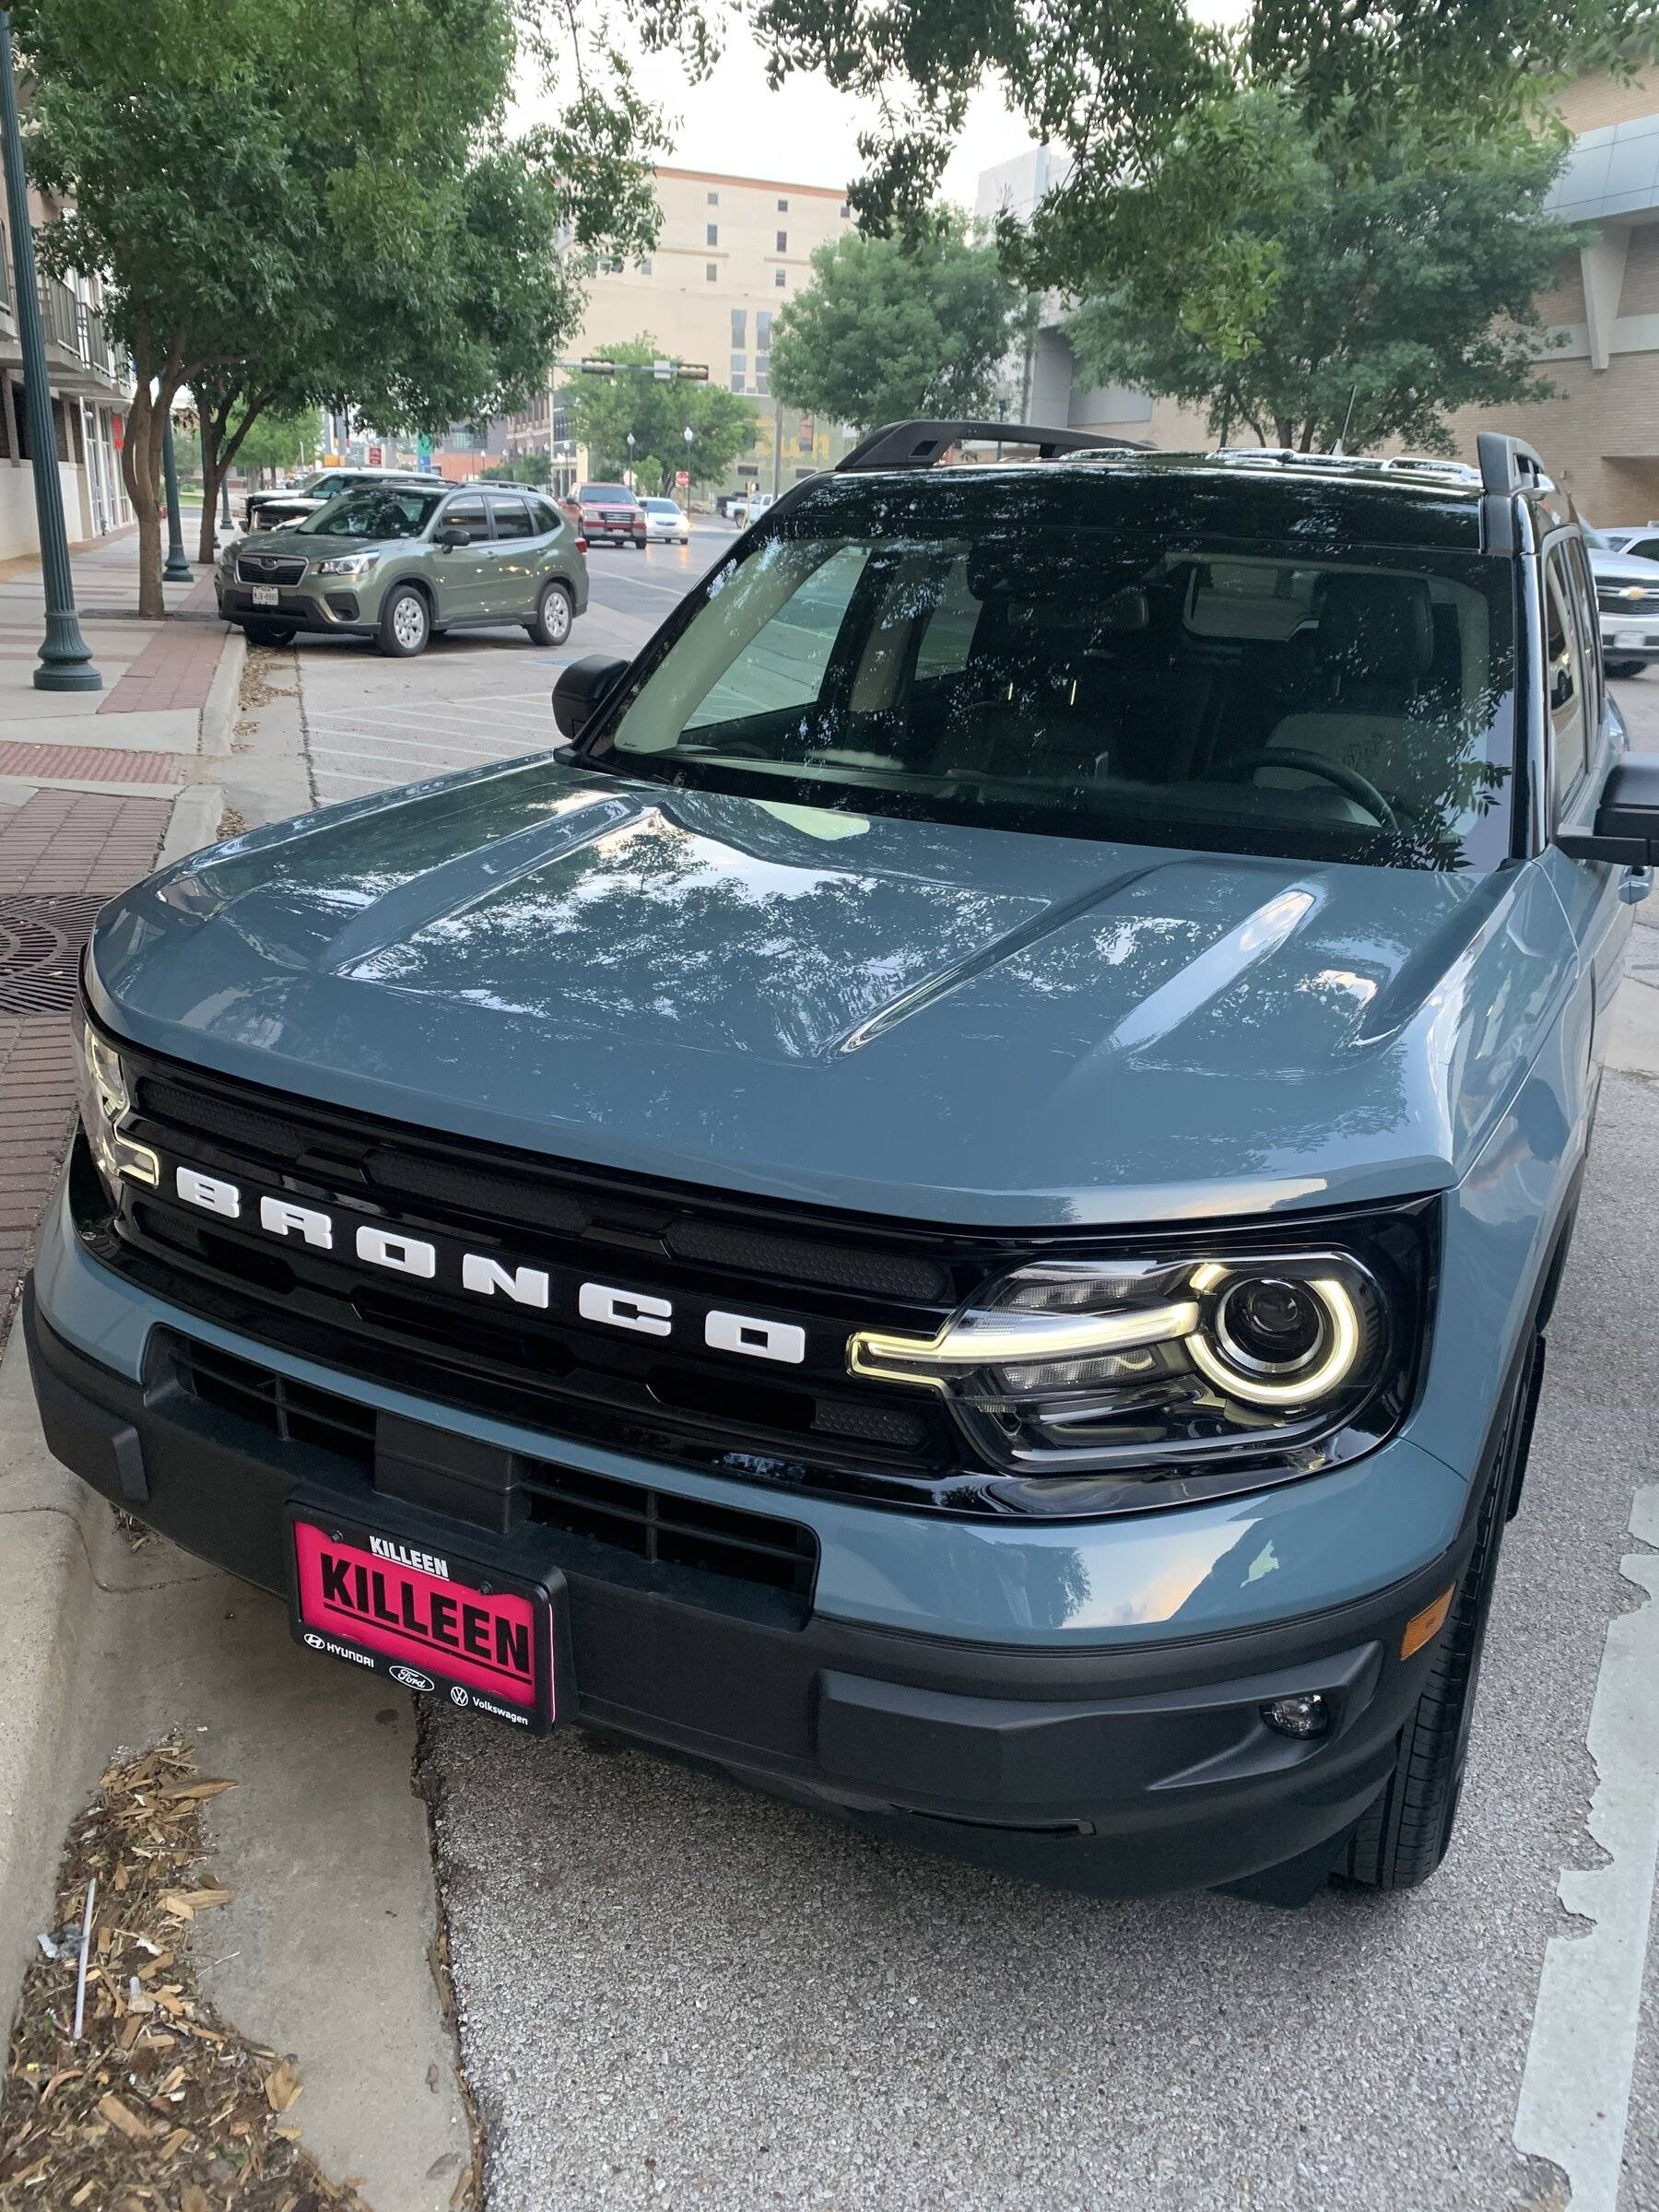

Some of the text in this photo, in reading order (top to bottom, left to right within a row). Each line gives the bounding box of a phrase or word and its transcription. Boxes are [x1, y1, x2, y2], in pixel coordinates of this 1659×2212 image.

[175, 1165, 806, 1364] BRONCO
[370, 1535, 450, 1578] KILLEEN
[320, 1552, 530, 1675] KILLEEN
[326, 1641, 375, 1669] HYUNDAI
[397, 1667, 427, 1689] Ford
[472, 1696, 529, 1726] Volkswagen
